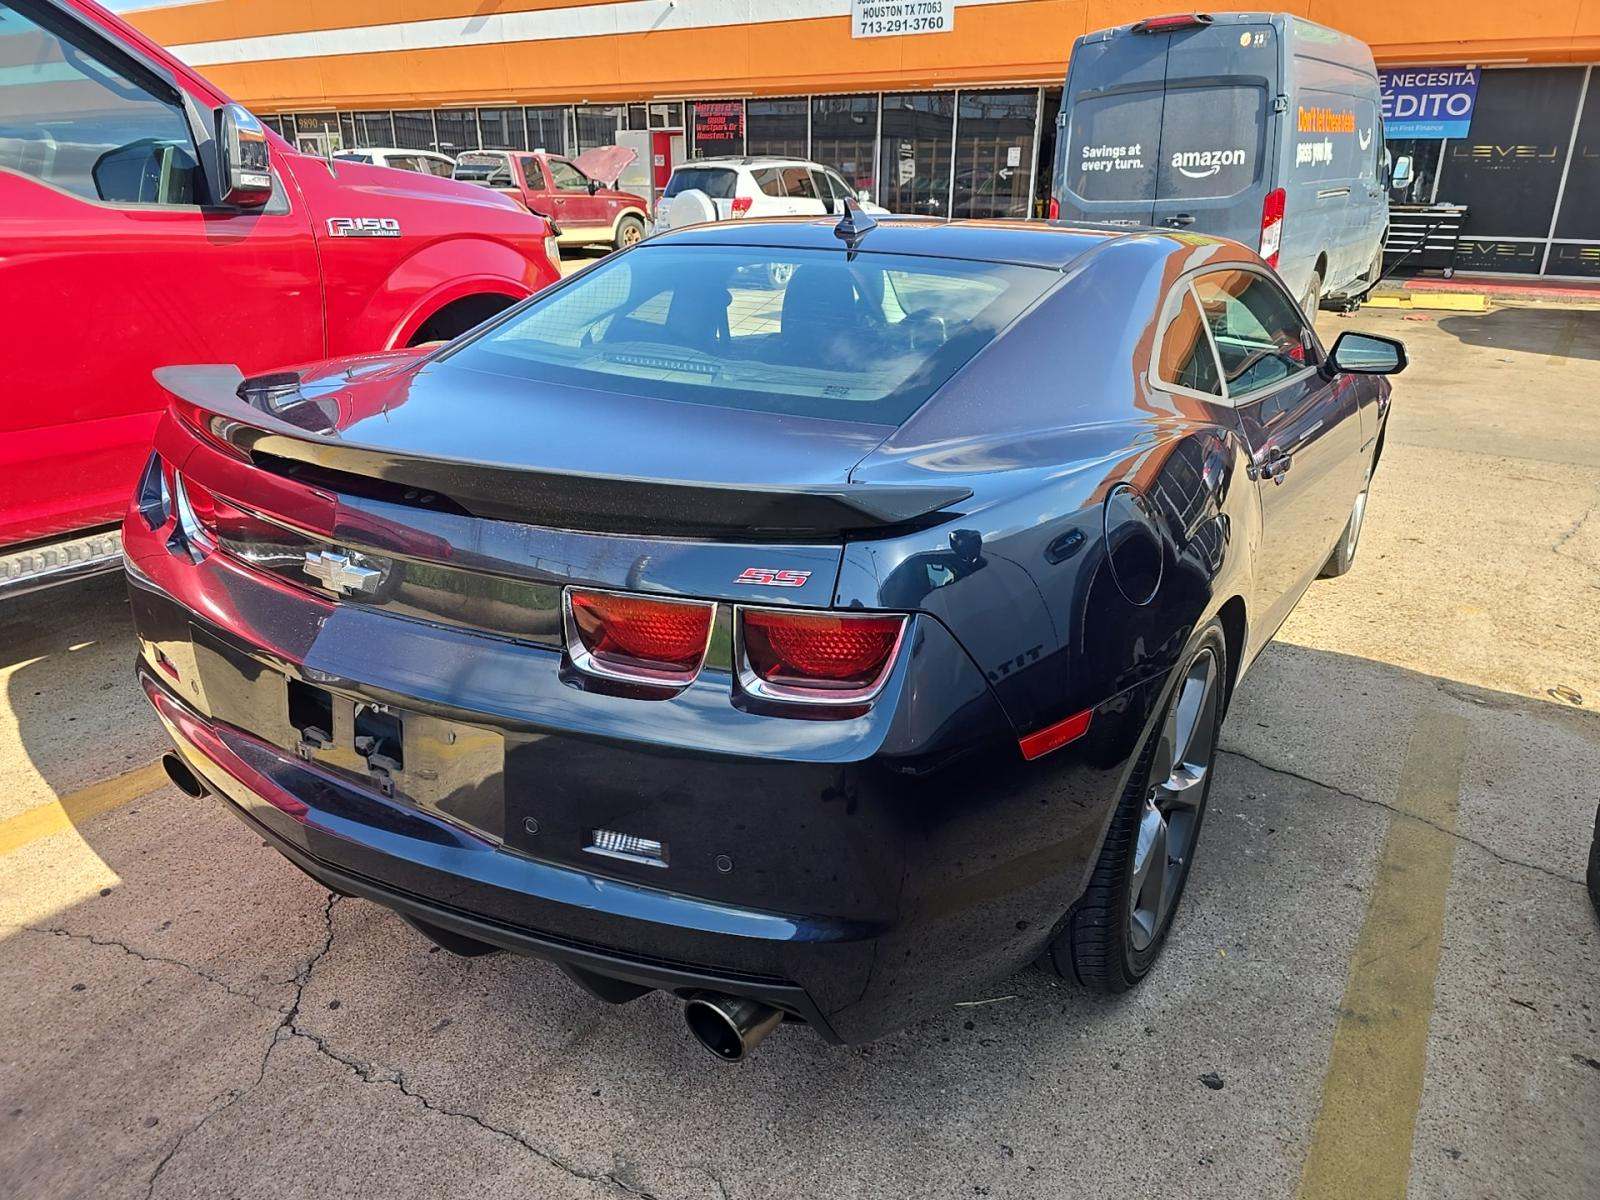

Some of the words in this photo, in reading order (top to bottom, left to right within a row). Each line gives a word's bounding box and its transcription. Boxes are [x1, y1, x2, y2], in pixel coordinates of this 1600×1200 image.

[863, 6, 902, 19] HOUSTON
[905, 4, 915, 15] TX
[918, 2, 942, 15] 77063
[861, 17, 943, 34] 713-291-3760
[1392, 72, 1475, 87] NECESITA
[1082, 144, 1126, 159] Savings
[1128, 143, 1141, 156] at
[1172, 149, 1246, 168] amazon
[1081, 159, 1114, 172] every
[1115, 157, 1144, 170] turn.
[733, 568, 812, 587] SS
